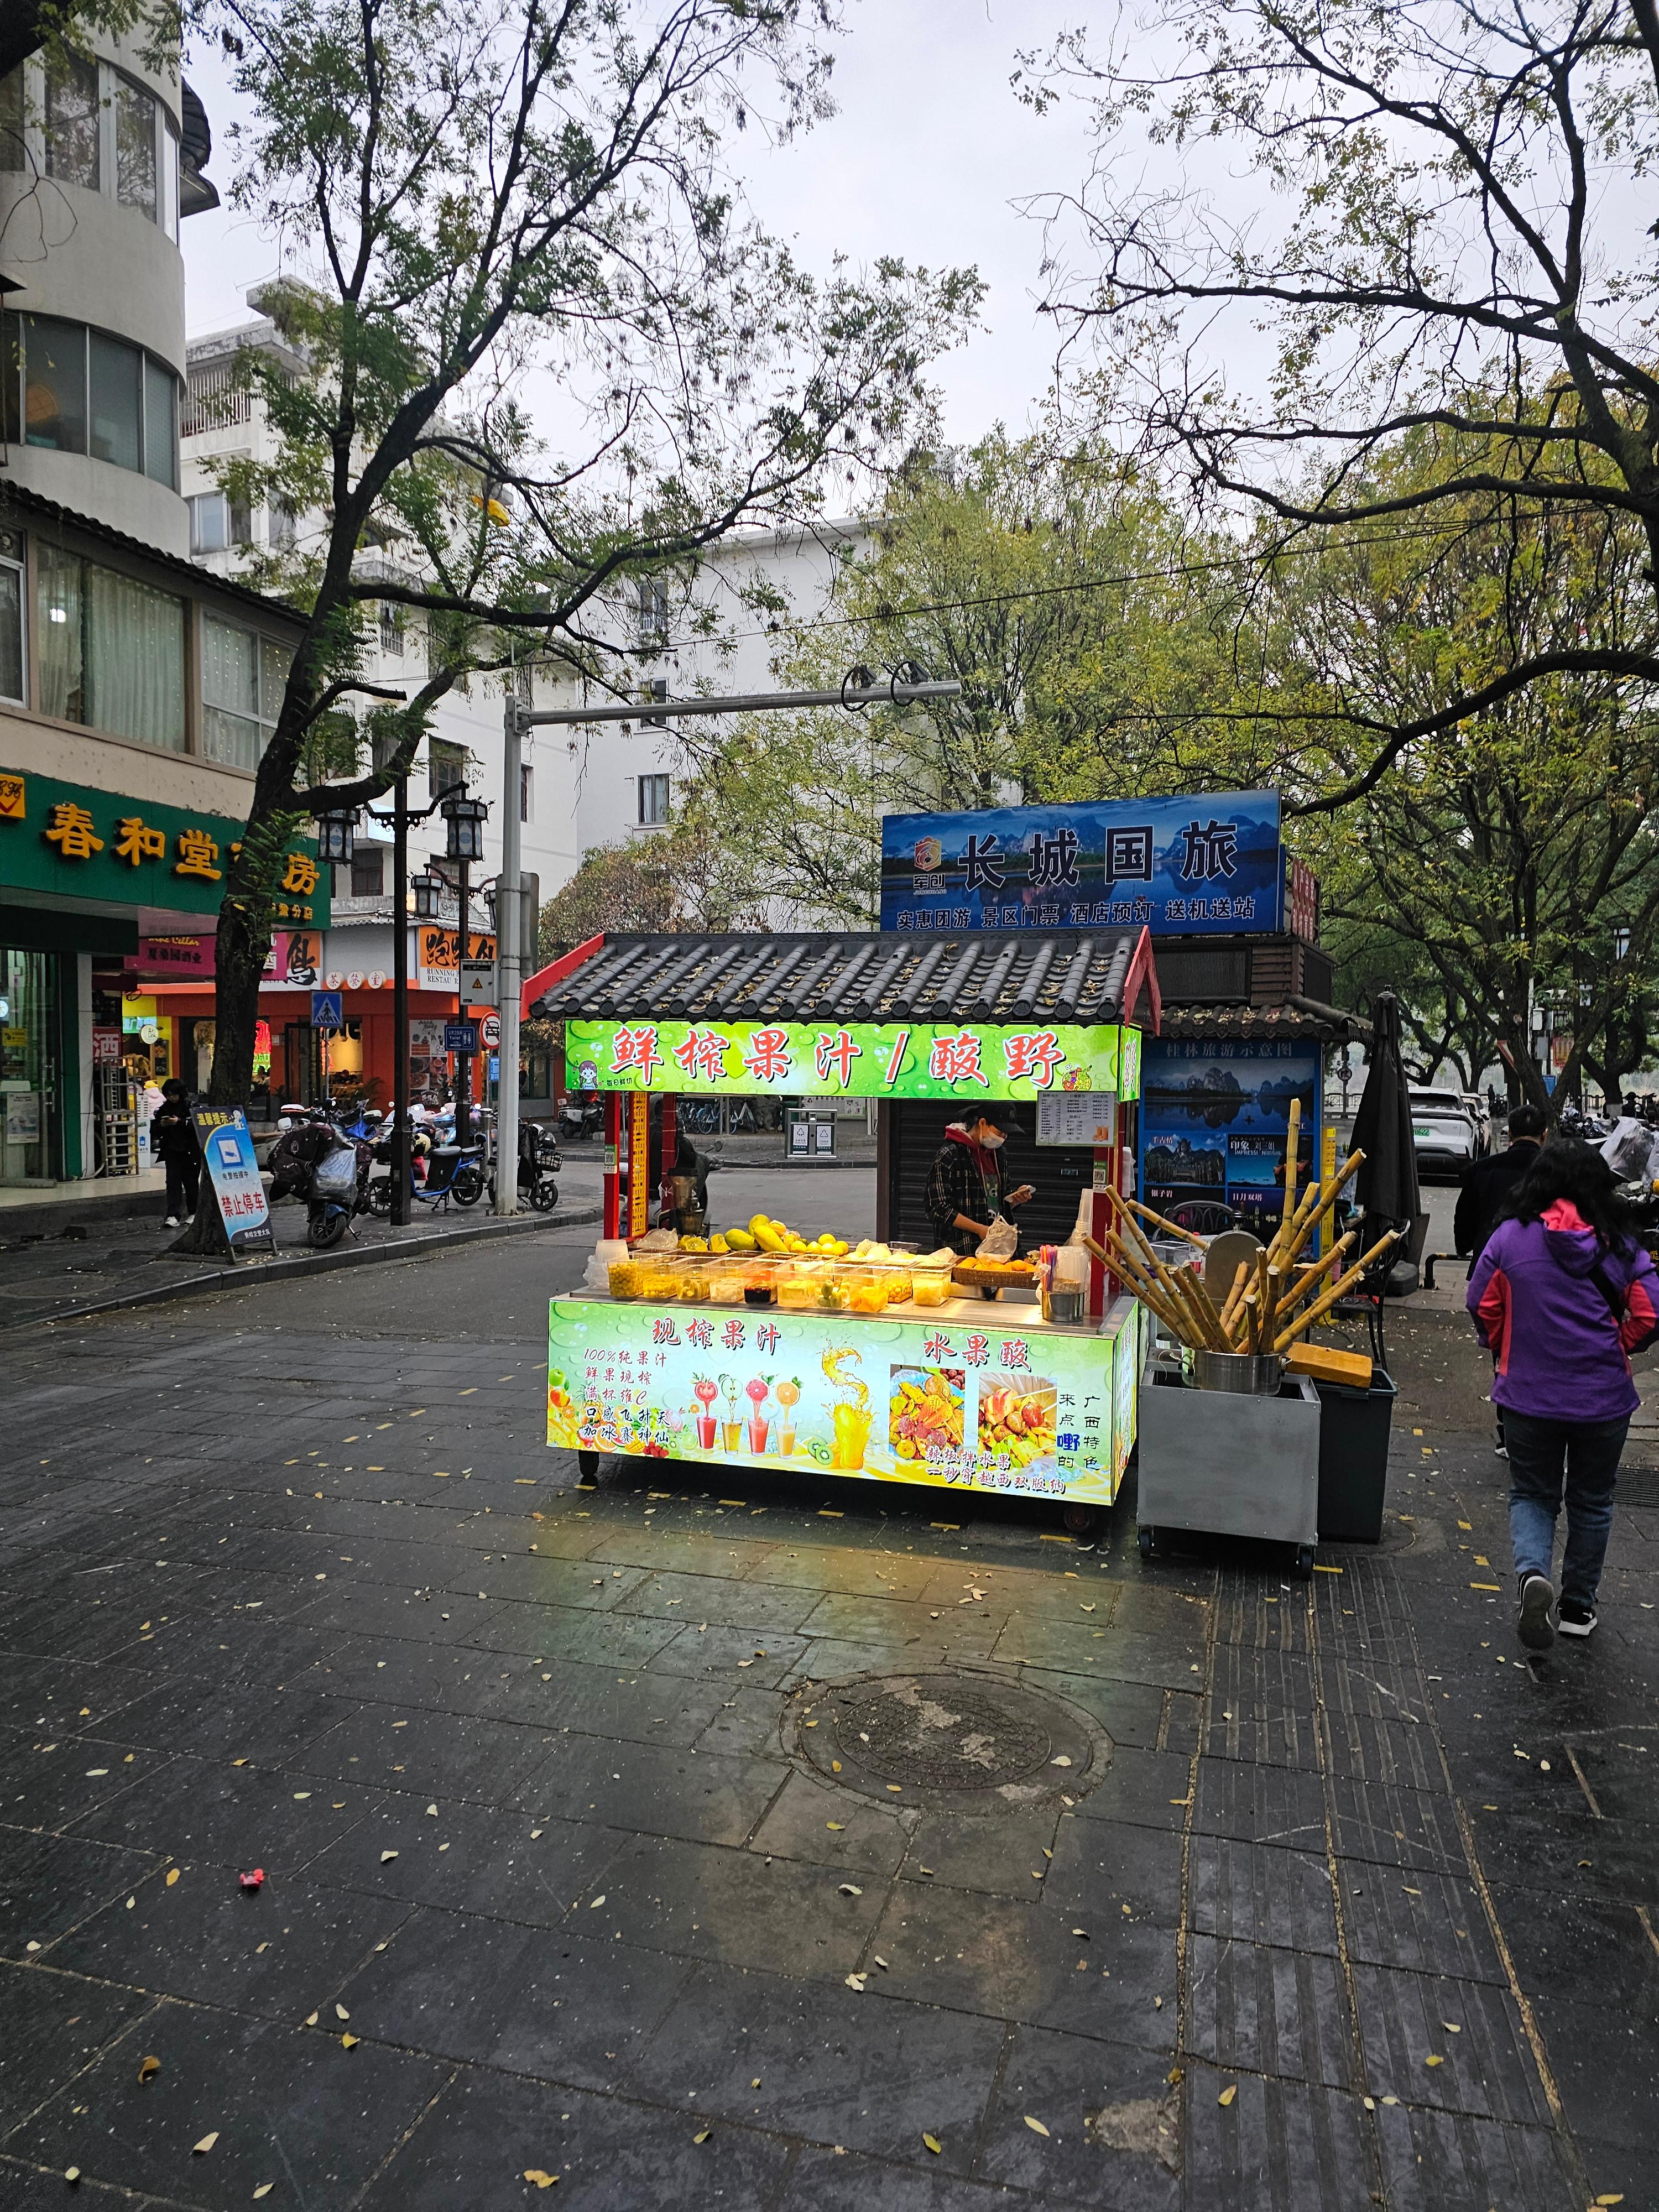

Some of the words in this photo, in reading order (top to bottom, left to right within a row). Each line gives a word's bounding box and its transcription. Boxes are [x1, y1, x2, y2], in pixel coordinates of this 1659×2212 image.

[46, 803, 320, 895] 春和堂房
[958, 820, 1237, 893] 长城国旅
[913, 873, 946, 889] 军创
[897, 908, 971, 930] 实惠团游
[981, 904, 1060, 927] 景区门票
[1070, 900, 1154, 924] 酒店预订
[1165, 896, 1256, 921] 送机送站
[427, 968, 455, 976] RUNNING
[93, 1032, 120, 1058] 酒
[1166, 1042, 1292, 1057] 桂林旅游示意图
[608, 1025, 1067, 1091] 鲜榨果汁/酸野
[607, 1078, 632, 1087] 每日鲜切
[197, 1112, 228, 1126] 温馨提示
[1230, 1140, 1249, 1151] 印象
[221, 1191, 265, 1218] 禁止停车
[652, 1317, 781, 1355] 现榨果汁
[583, 1348, 667, 1368] 100%纯果汁
[923, 1331, 1031, 1372] 水果酸
[585, 1365, 653, 1385] 鲜果现榨
[584, 1385, 648, 1405] 满杯维C
[586, 1405, 671, 1427] 口感飞升天
[1084, 1393, 1101, 1471] 广西特色
[926, 1446, 1012, 1470] 辣椒拌水果
[926, 1465, 1066, 1494] 一秒穿越西双版纳
